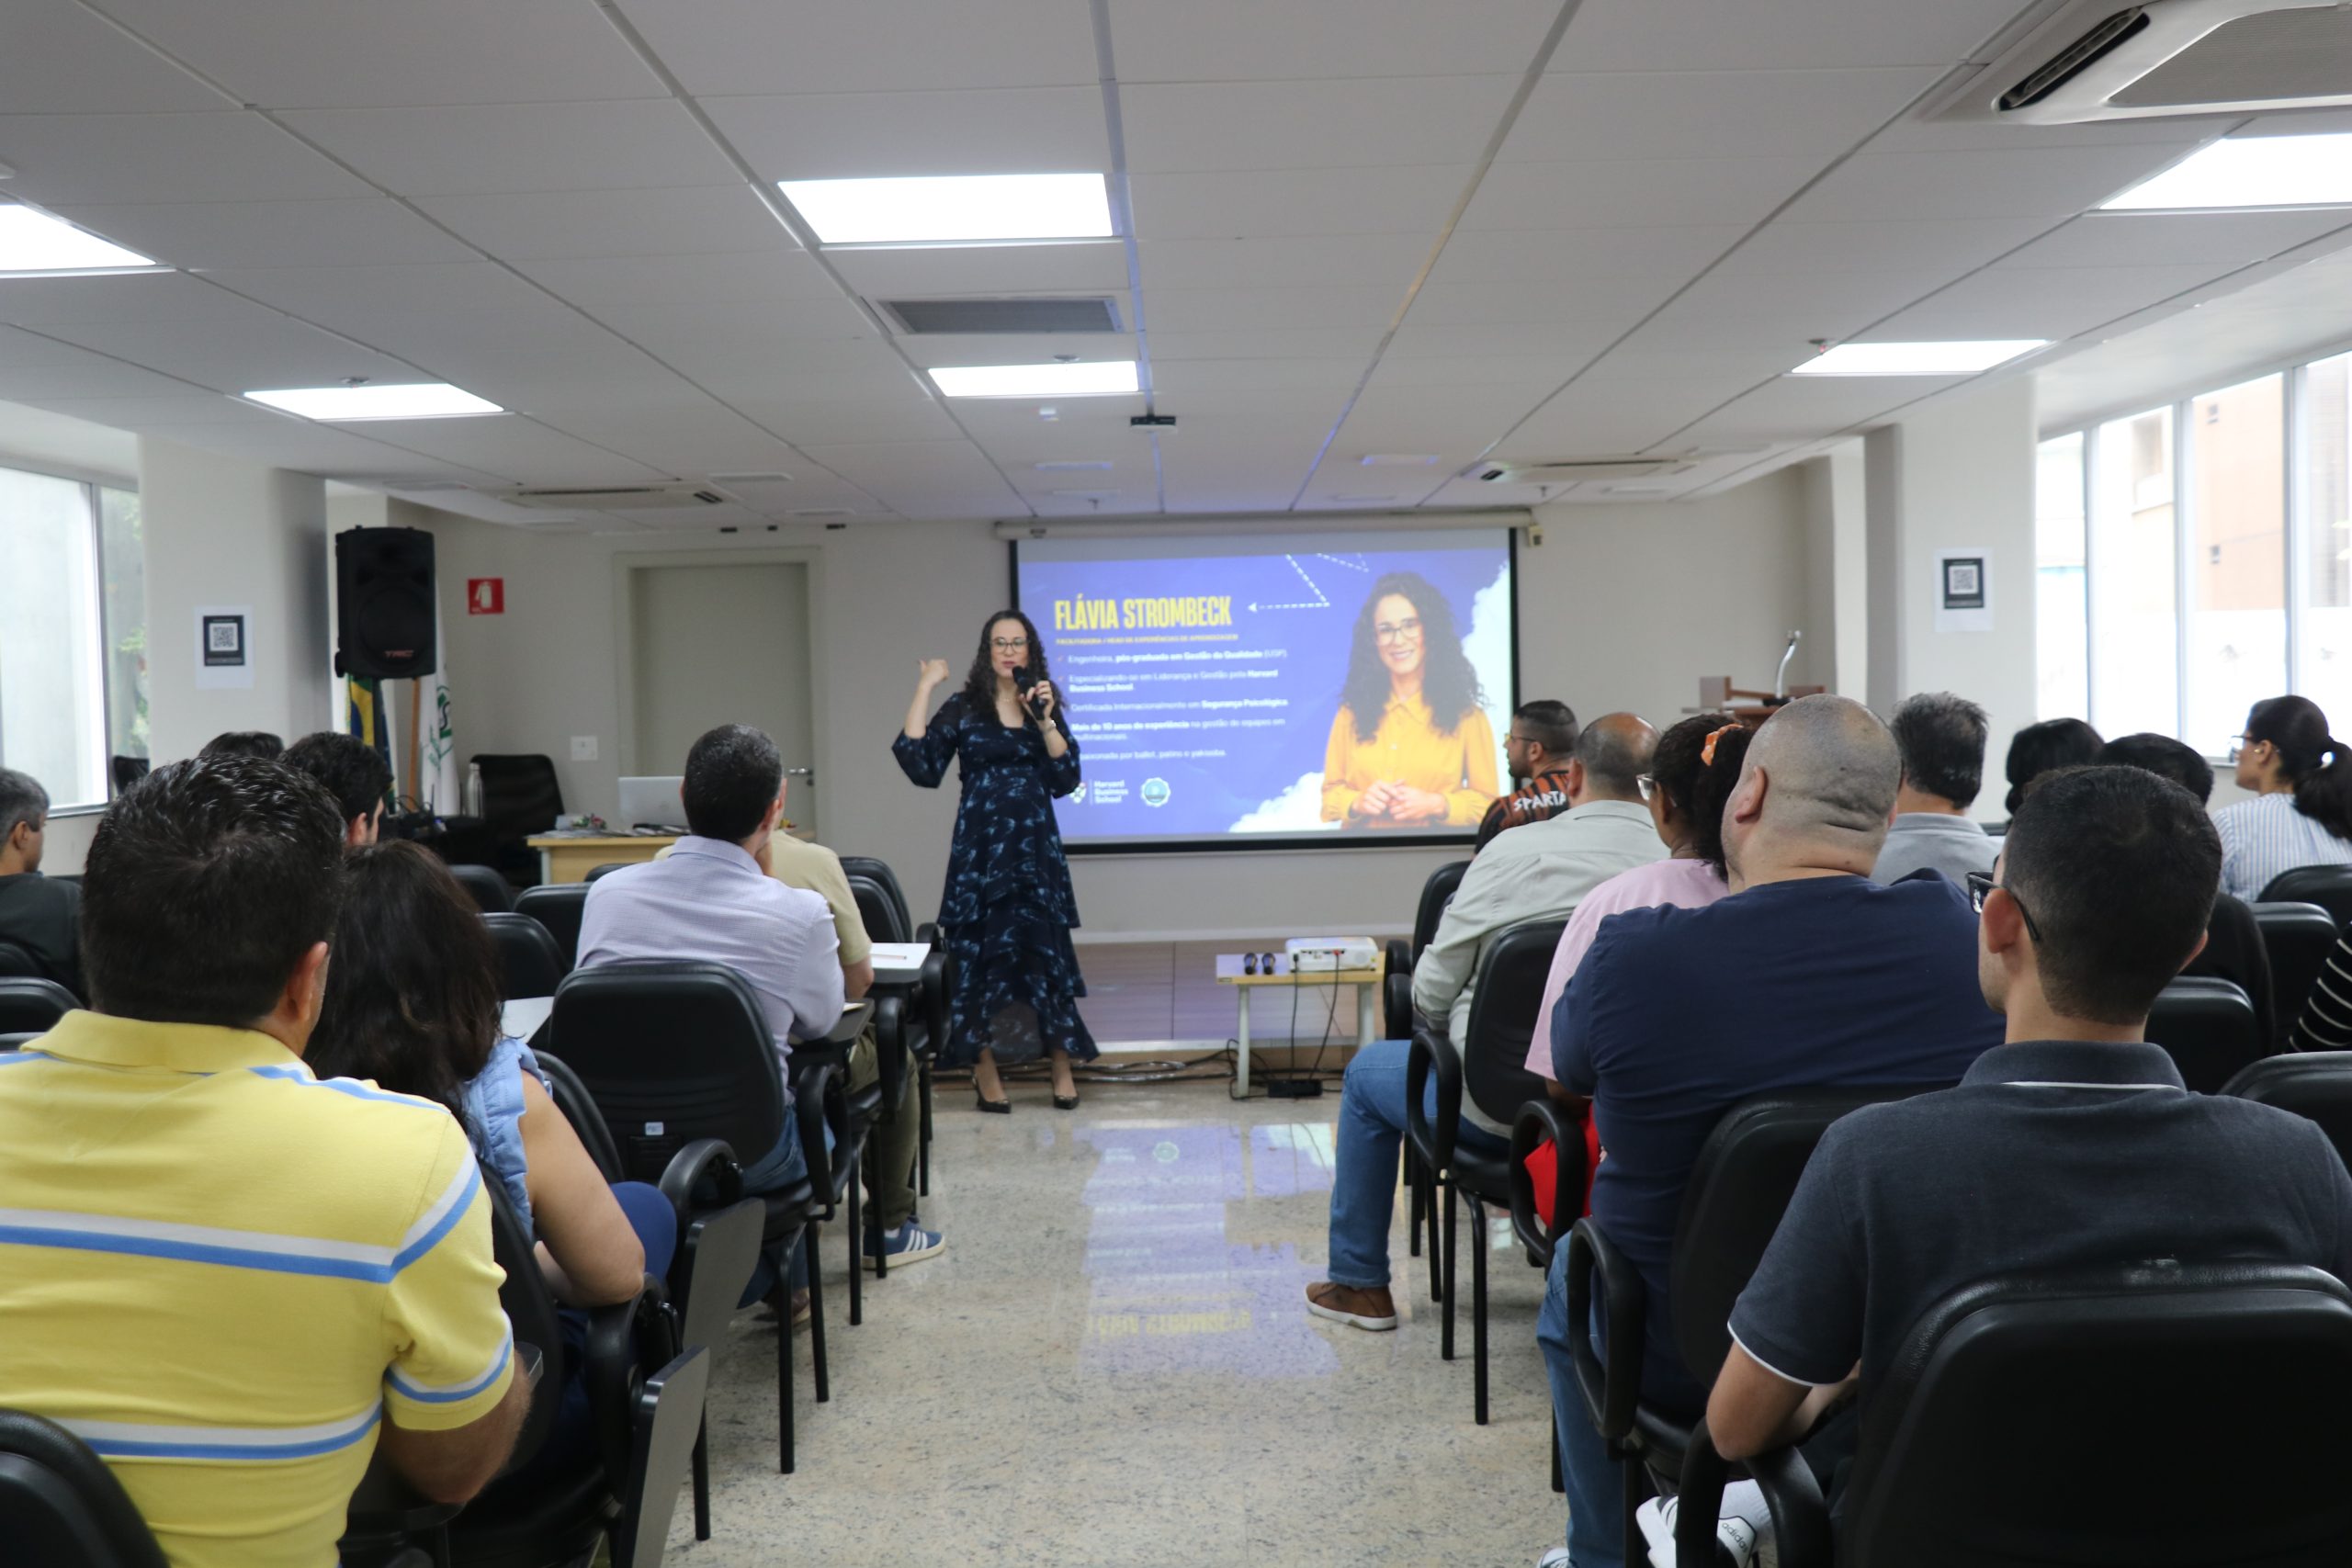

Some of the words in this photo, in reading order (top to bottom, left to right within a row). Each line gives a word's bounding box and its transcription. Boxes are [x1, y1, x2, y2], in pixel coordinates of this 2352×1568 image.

[1055, 592, 1119, 630] FLÁVIA
[1124, 595, 1232, 629] STROMBECK
[1248, 669, 1278, 678] Harvard
[1069, 684, 1105, 693] Business
[1071, 723, 1091, 731] Mais
